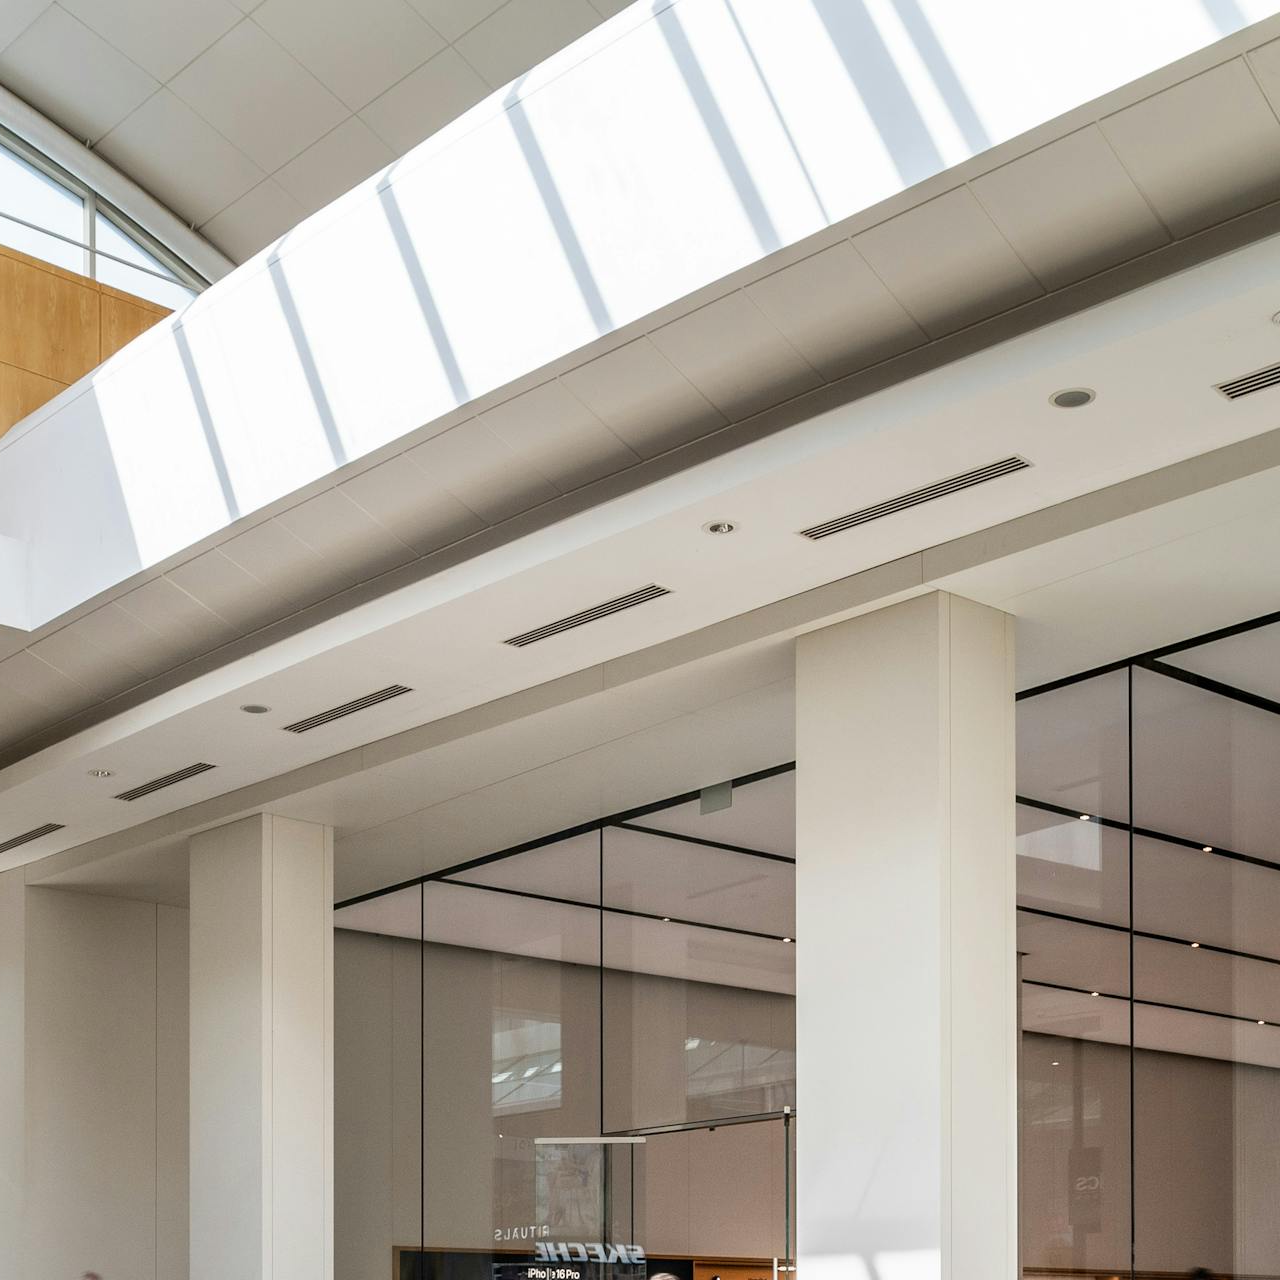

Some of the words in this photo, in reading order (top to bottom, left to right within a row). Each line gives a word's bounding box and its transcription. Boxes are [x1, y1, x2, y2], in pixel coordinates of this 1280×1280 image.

[528, 1268, 556, 1279] iPhoe
[556, 1269, 565, 1279] 16
[566, 1269, 580, 1279] Pro
